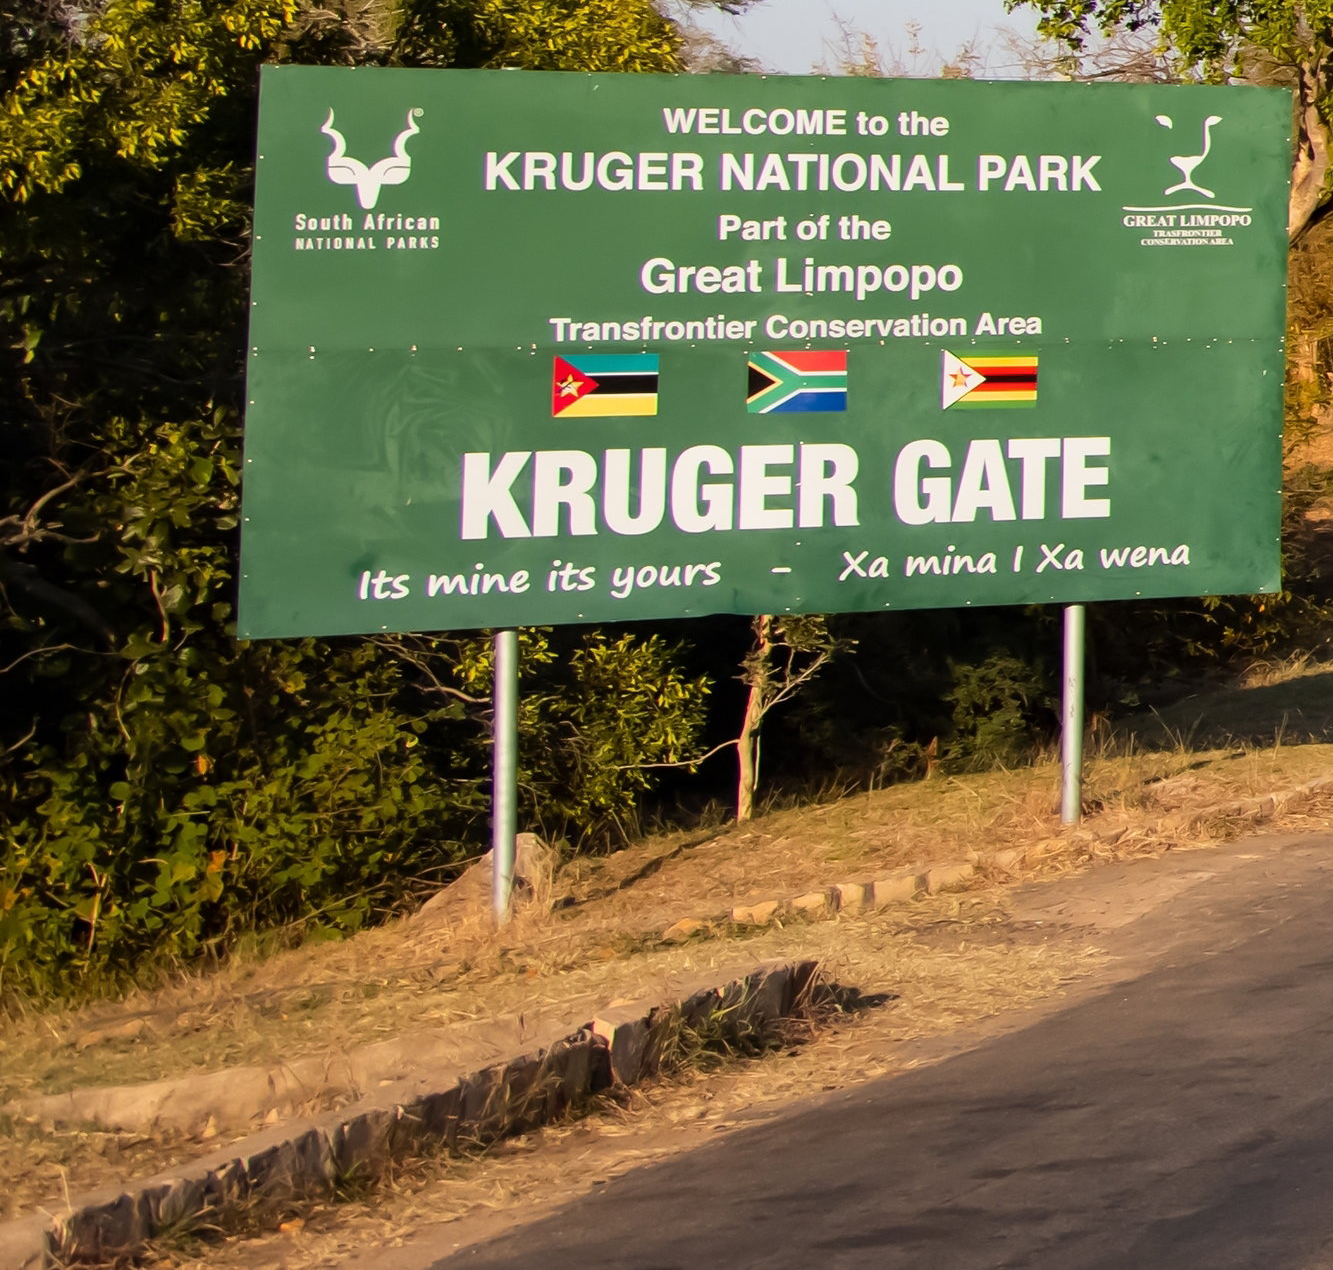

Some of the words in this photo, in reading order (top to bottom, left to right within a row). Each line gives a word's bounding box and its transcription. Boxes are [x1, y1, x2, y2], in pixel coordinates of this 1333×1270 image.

[663, 107, 847, 136] WELCOME
[856, 110, 889, 136] to
[896, 110, 950, 137] the
[484, 151, 704, 192] KRUGER
[719, 152, 964, 192] NATIONAL
[978, 155, 1103, 192] PARK
[294, 213, 353, 231] South
[363, 213, 440, 231] African
[719, 215, 788, 241] Part
[796, 215, 831, 241] of
[838, 214, 892, 241] the
[1122, 214, 1177, 227] GREAT
[1179, 214, 1252, 227] LIMPOPO
[294, 236, 377, 250] NATIONAL
[386, 235, 439, 249] PARKS
[1140, 237, 1209, 246] CONSERVATION
[1210, 237, 1235, 245] AREA
[641, 257, 763, 295] Great
[775, 257, 964, 300] Limpopo
[548, 314, 758, 342] Transfrontier
[764, 312, 968, 340] Conservation
[974, 312, 1043, 336] Area
[460, 442, 860, 541] KRUGER
[893, 436, 1111, 526] GATE
[359, 569, 411, 601] Its
[427, 562, 531, 598] mine
[547, 559, 596, 593] its
[609, 561, 722, 599] yours
[838, 550, 890, 582] Xa
[905, 544, 998, 577] mina
[1035, 543, 1085, 574] Xa
[1099, 544, 1191, 570] wena
